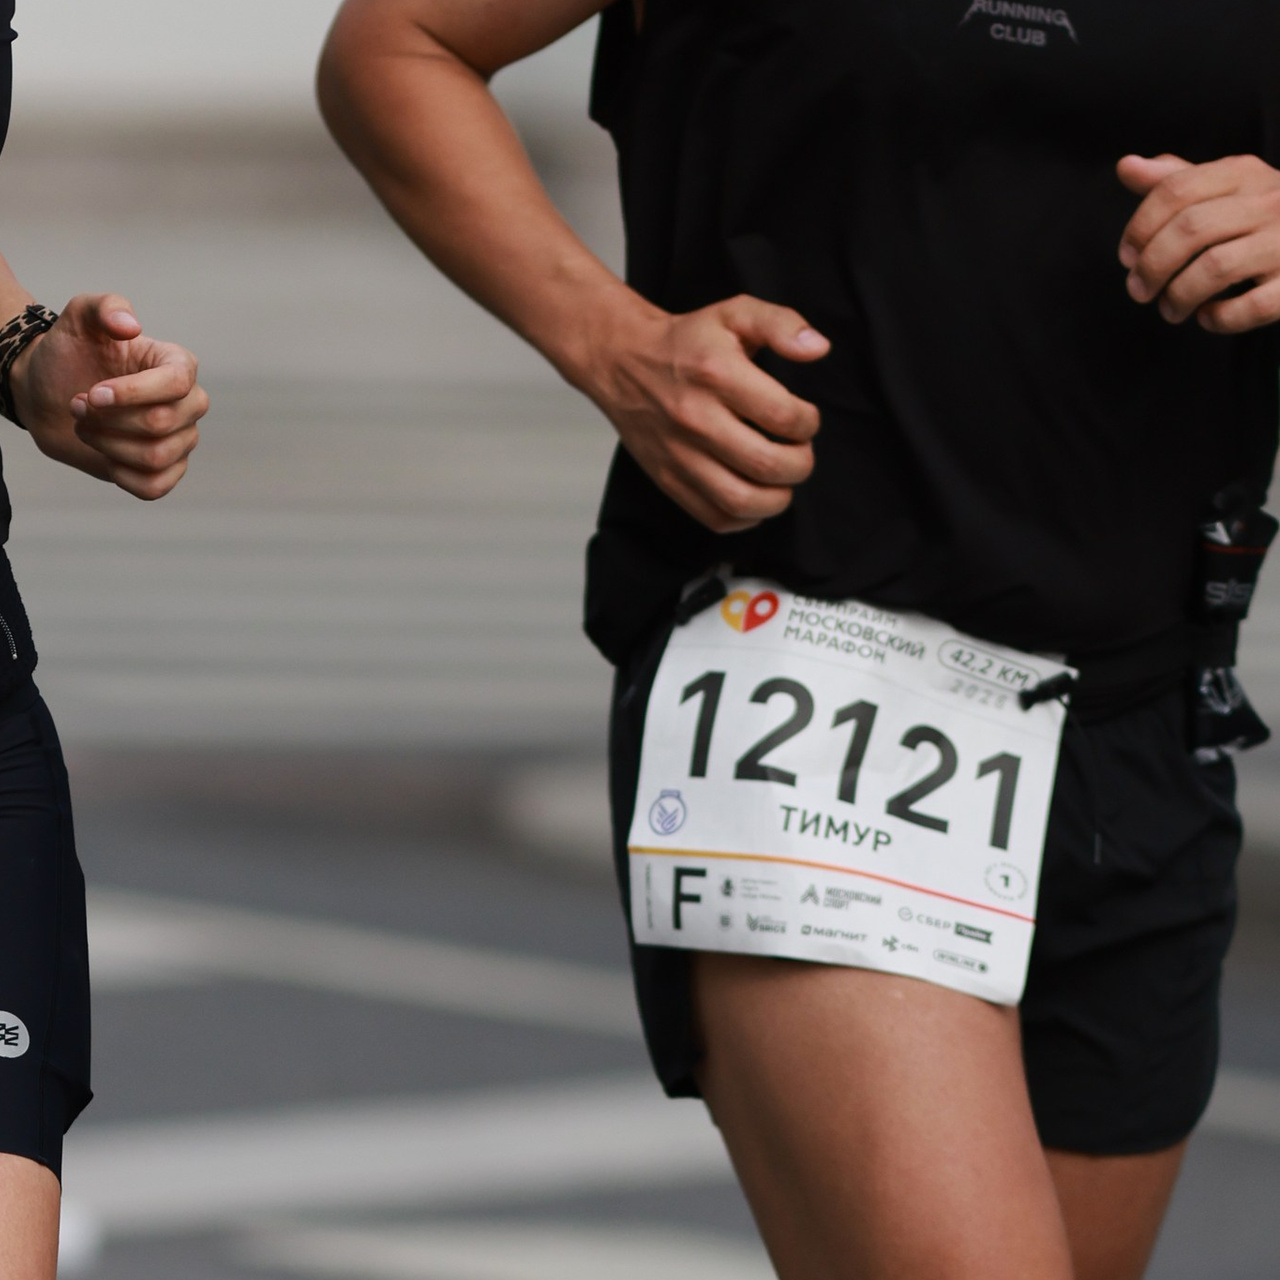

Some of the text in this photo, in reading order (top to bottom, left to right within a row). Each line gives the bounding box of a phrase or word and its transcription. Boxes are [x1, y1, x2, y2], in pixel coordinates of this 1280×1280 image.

[990, 22, 1046, 46] CLUB
[783, 626, 886, 664] МАРАФОН
[789, 608, 927, 660] МОСКОВСКИЙ
[949, 648, 993, 675] 42,2
[678, 669, 1022, 852] 12121
[779, 804, 892, 853] ТИМУР
[672, 866, 707, 930] F
